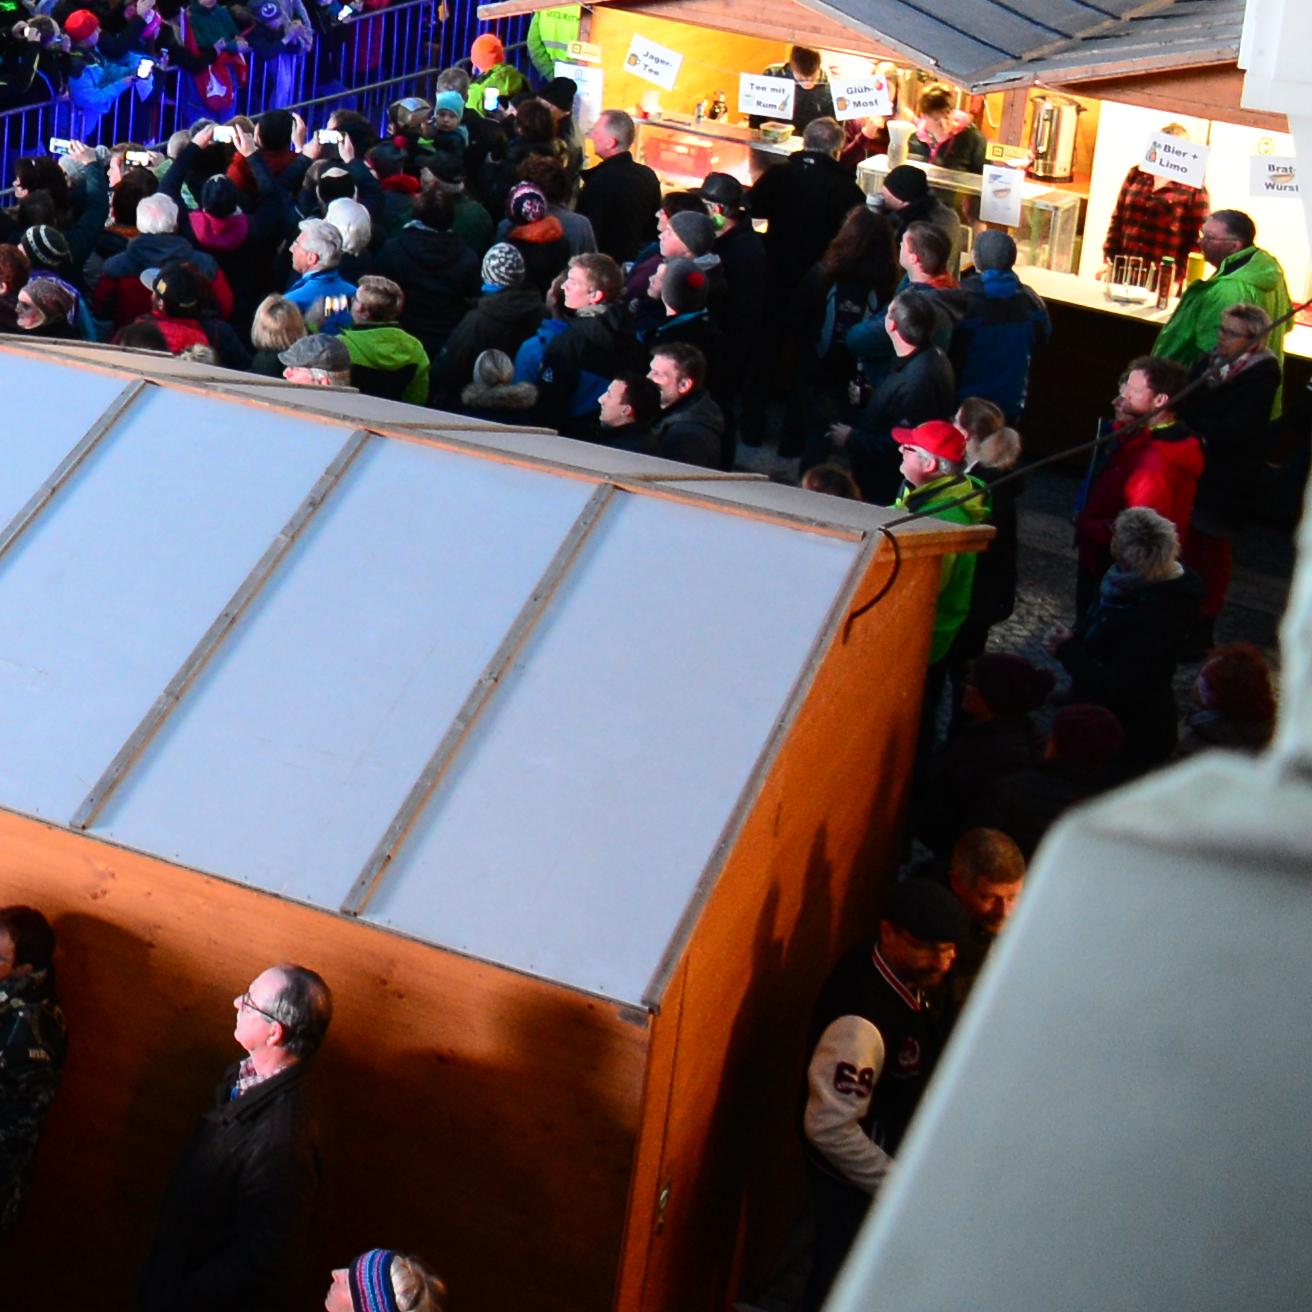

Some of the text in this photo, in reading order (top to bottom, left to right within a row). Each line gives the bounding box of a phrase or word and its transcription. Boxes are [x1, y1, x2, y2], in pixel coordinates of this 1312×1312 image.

[642, 64, 660, 76] Tee
[749, 82, 786, 95] Tee mit
[755, 100, 777, 110] Rum
[852, 99, 880, 108] Most
[1163, 144, 1199, 161] Bier +
[1158, 158, 1189, 174] Limo
[1267, 163, 1297, 174] Brat-
[1264, 181, 1299, 192] Wurst
